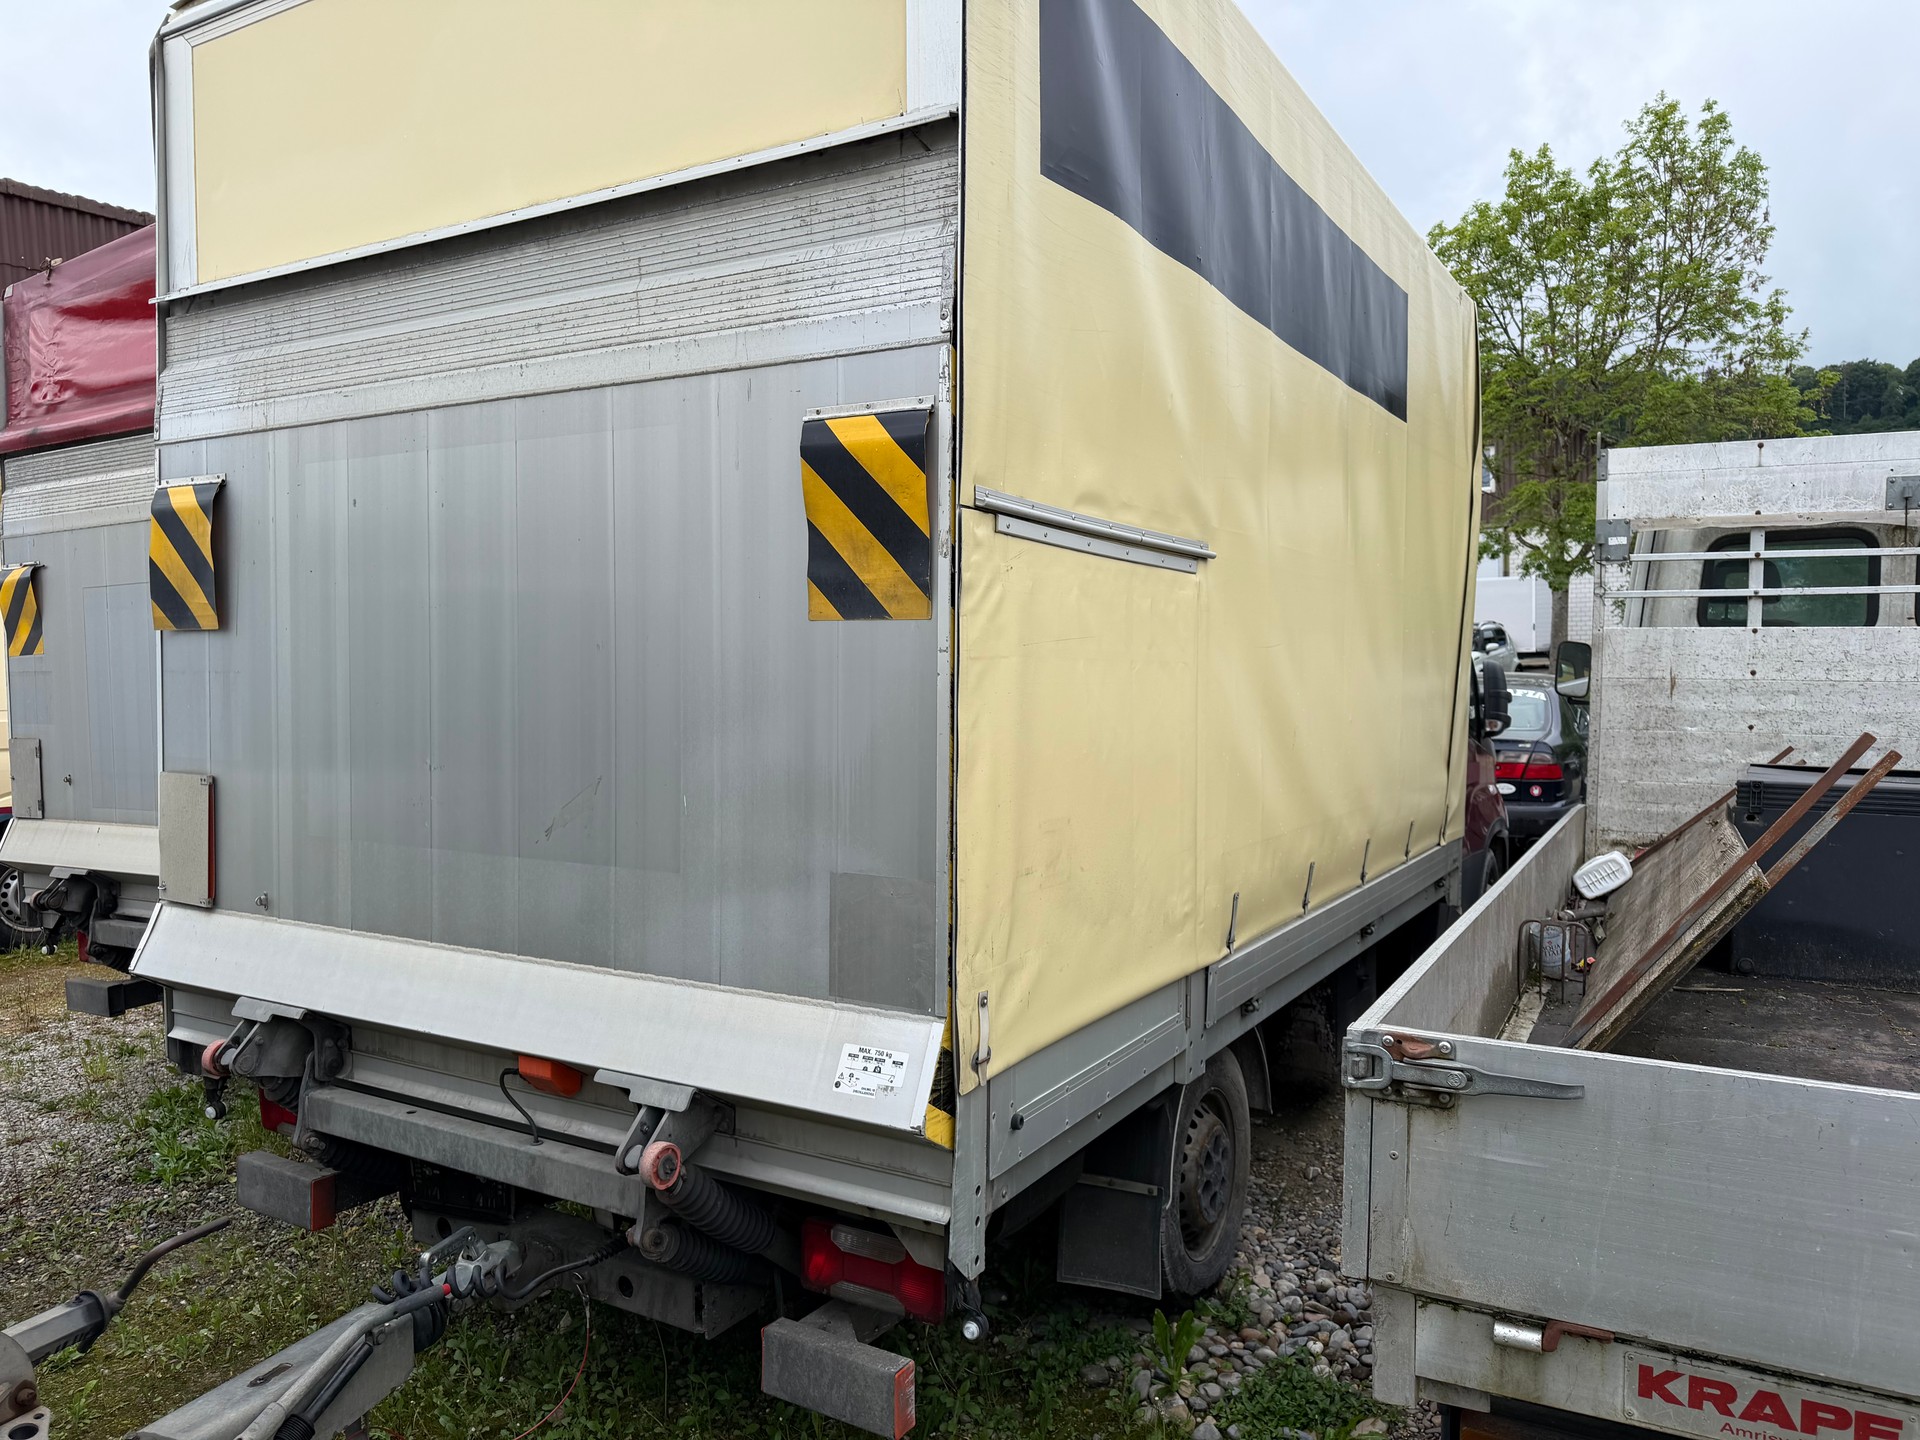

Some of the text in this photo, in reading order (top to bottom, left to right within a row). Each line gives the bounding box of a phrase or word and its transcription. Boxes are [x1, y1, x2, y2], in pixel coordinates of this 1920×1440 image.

[858, 1046, 893, 1059] MAX. 750 kg
